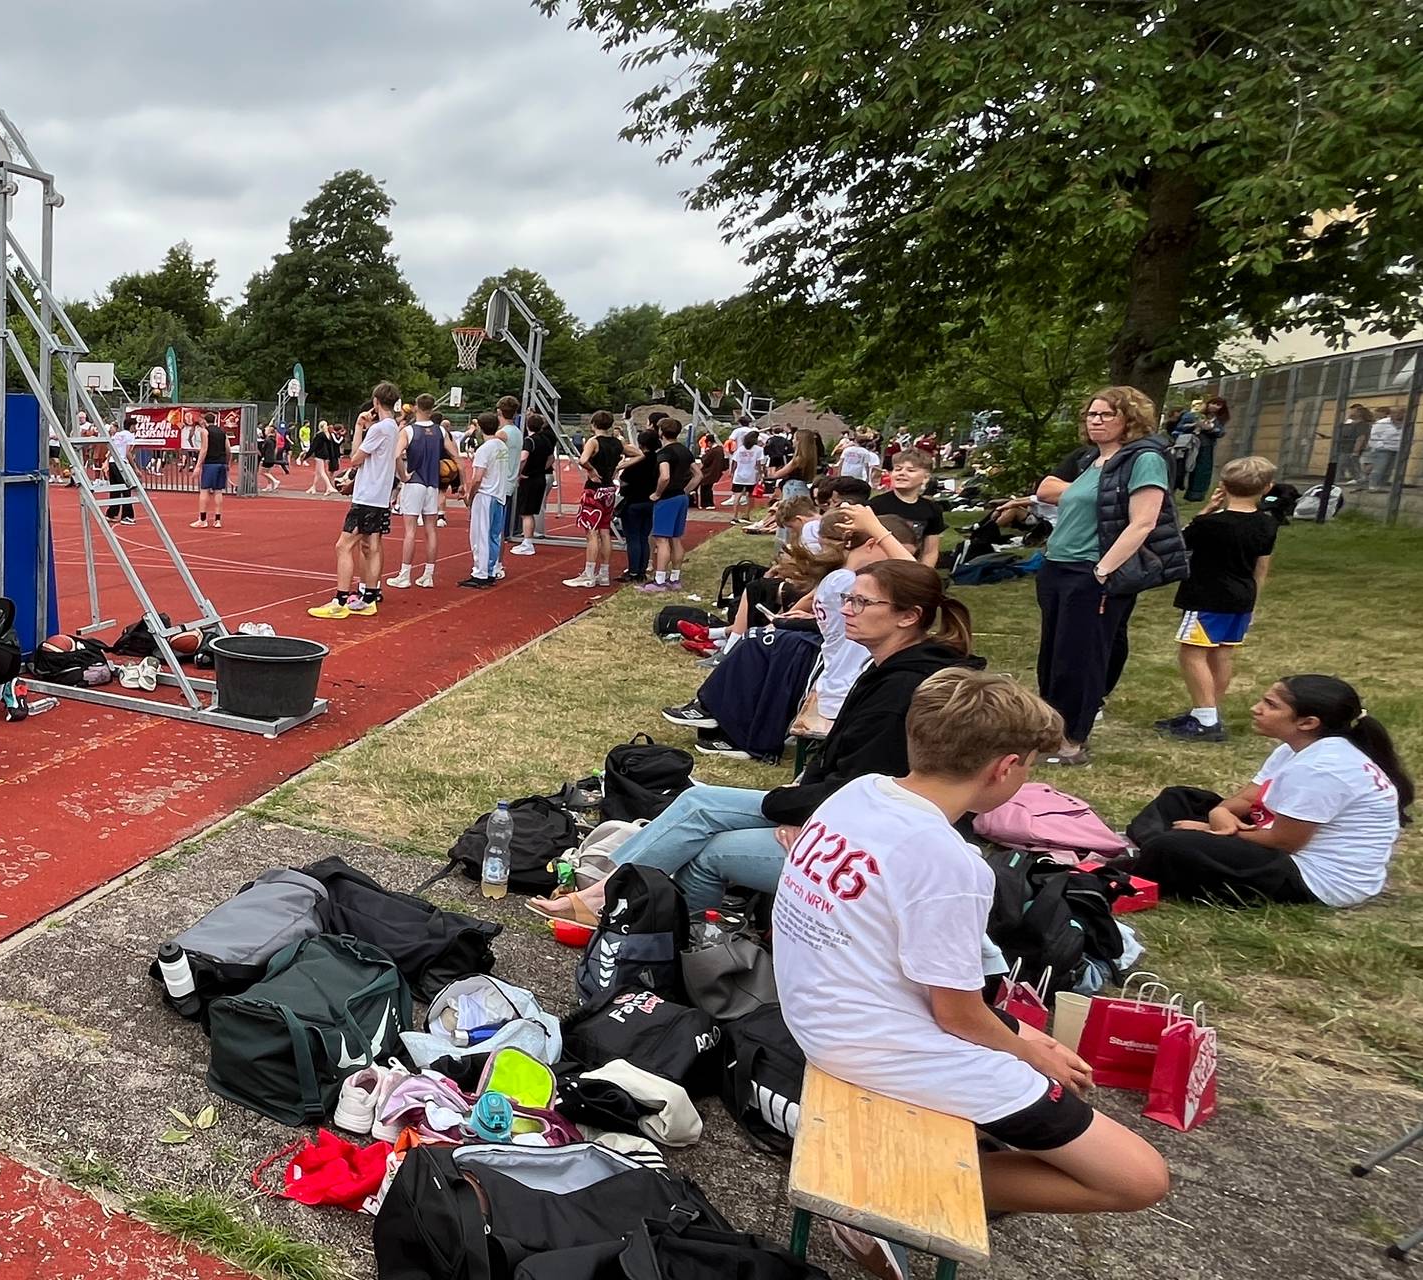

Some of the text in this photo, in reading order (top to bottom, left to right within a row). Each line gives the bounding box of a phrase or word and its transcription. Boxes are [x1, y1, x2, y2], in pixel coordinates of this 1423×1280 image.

[131, 414, 151, 422] EIN
[135, 422, 155, 430] LATZ
[135, 429, 179, 438] ASSISMUS!
[790, 821, 881, 901] 026
[783, 875, 835, 914] durch NRW
